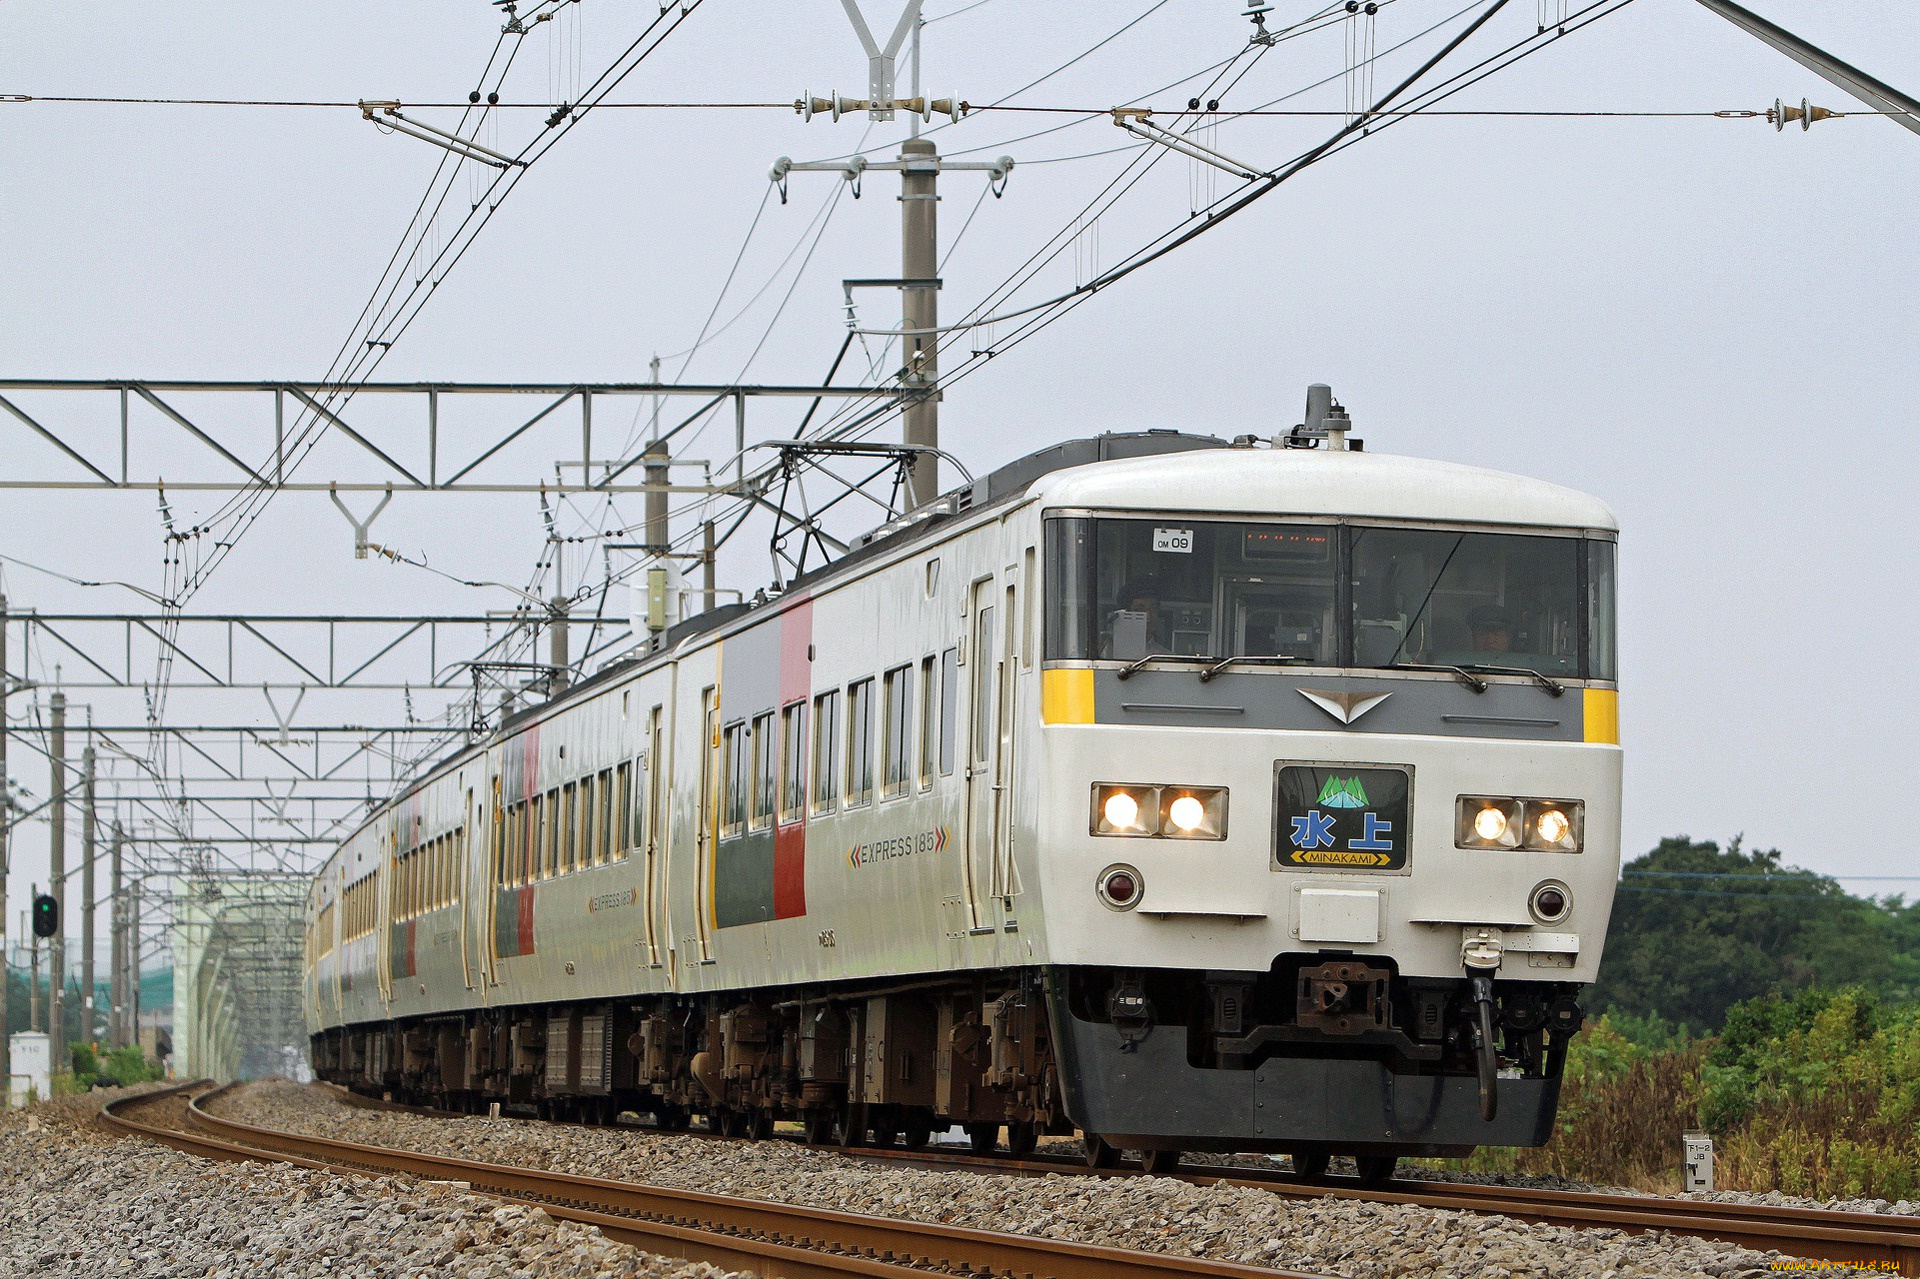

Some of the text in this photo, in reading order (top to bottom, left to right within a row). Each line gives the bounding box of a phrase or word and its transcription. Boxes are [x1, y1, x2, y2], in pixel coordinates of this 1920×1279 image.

[1157, 537, 1189, 549] OM 09
[1290, 810, 1393, 850] 水上
[861, 831, 934, 863] EXPRESS 185
[1308, 852, 1372, 864] MINAKAMI
